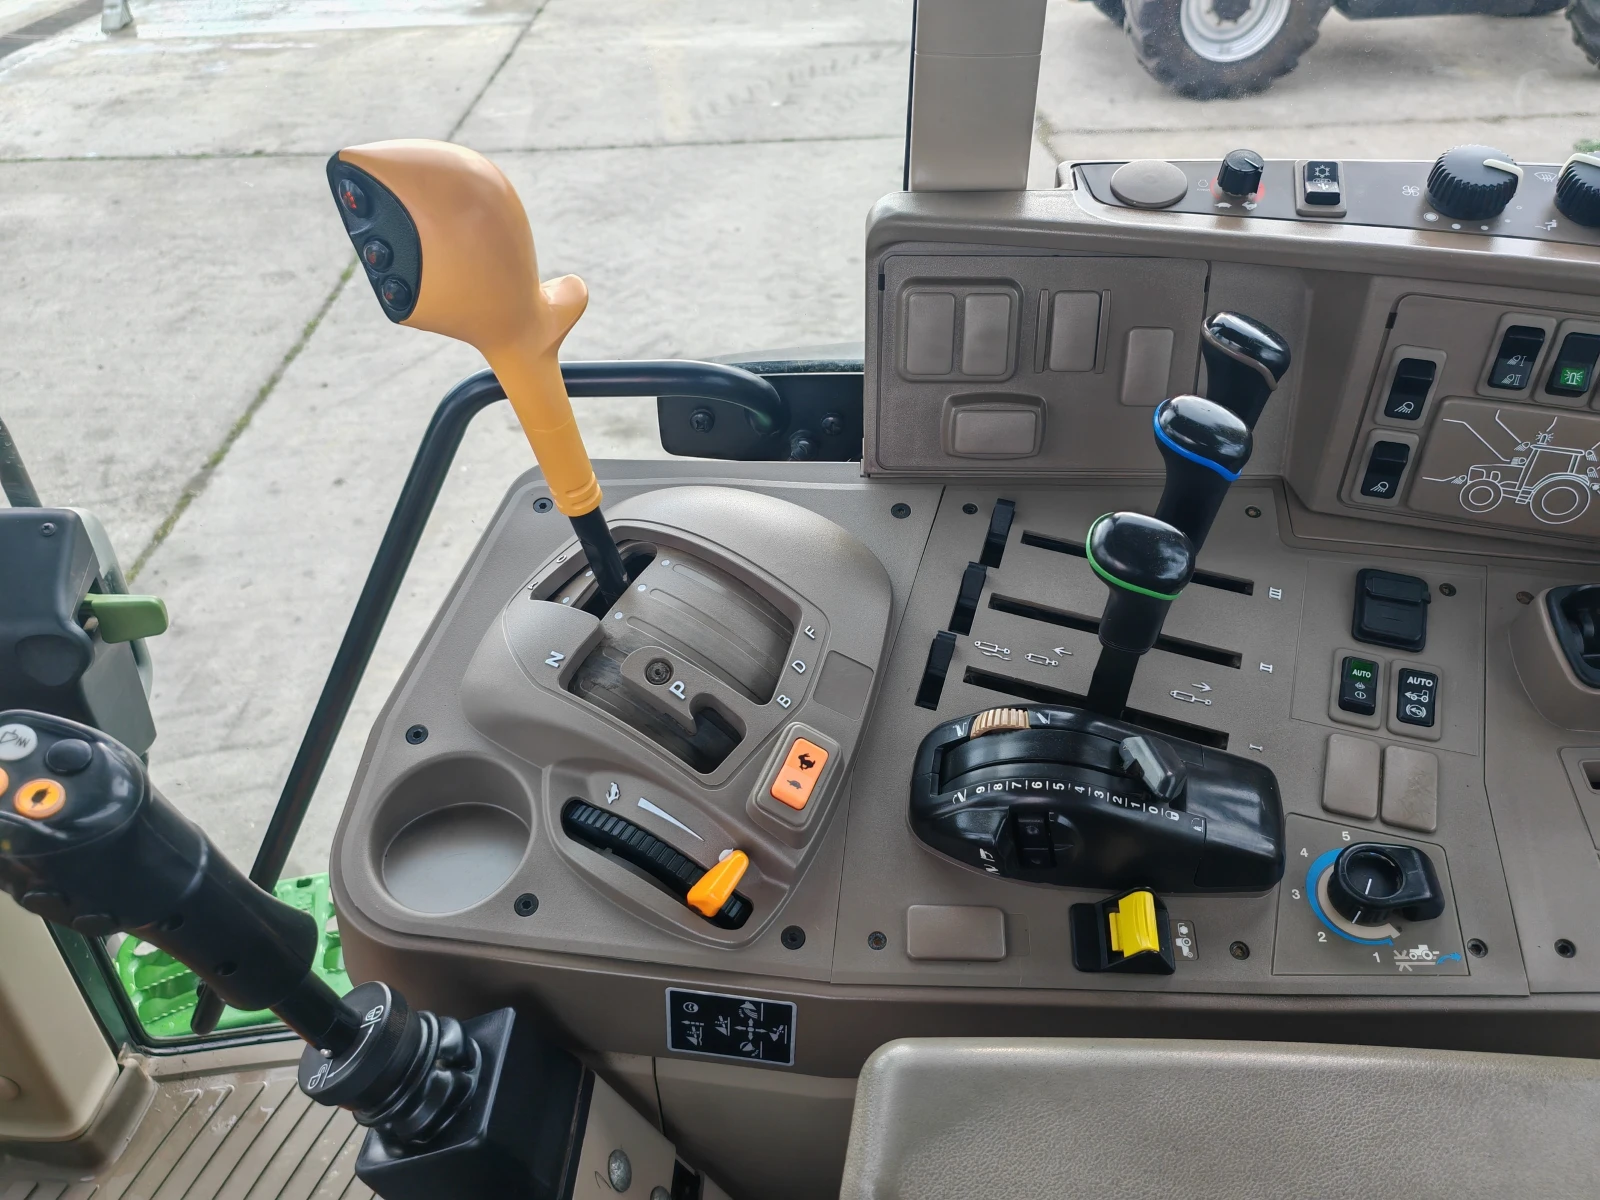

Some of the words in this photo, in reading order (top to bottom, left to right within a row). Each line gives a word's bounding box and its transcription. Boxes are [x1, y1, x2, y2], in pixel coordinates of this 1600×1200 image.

[804, 625, 815, 639] F
[545, 650, 565, 668] N
[792, 660, 806, 674] D
[1352, 669, 1371, 678] AUTO
[1406, 676, 1433, 687] AUTO
[668, 680, 686, 700] P
[776, 694, 791, 708] B
[1094, 790, 1104, 799] 3
[1113, 796, 1122, 804] 2
[1149, 806, 1158, 814] 0
[1342, 831, 1350, 841] 5
[1300, 847, 1308, 857] 4
[1291, 888, 1300, 899] 3
[1317, 931, 1327, 942] 2
[1373, 952, 1380, 963] 1
